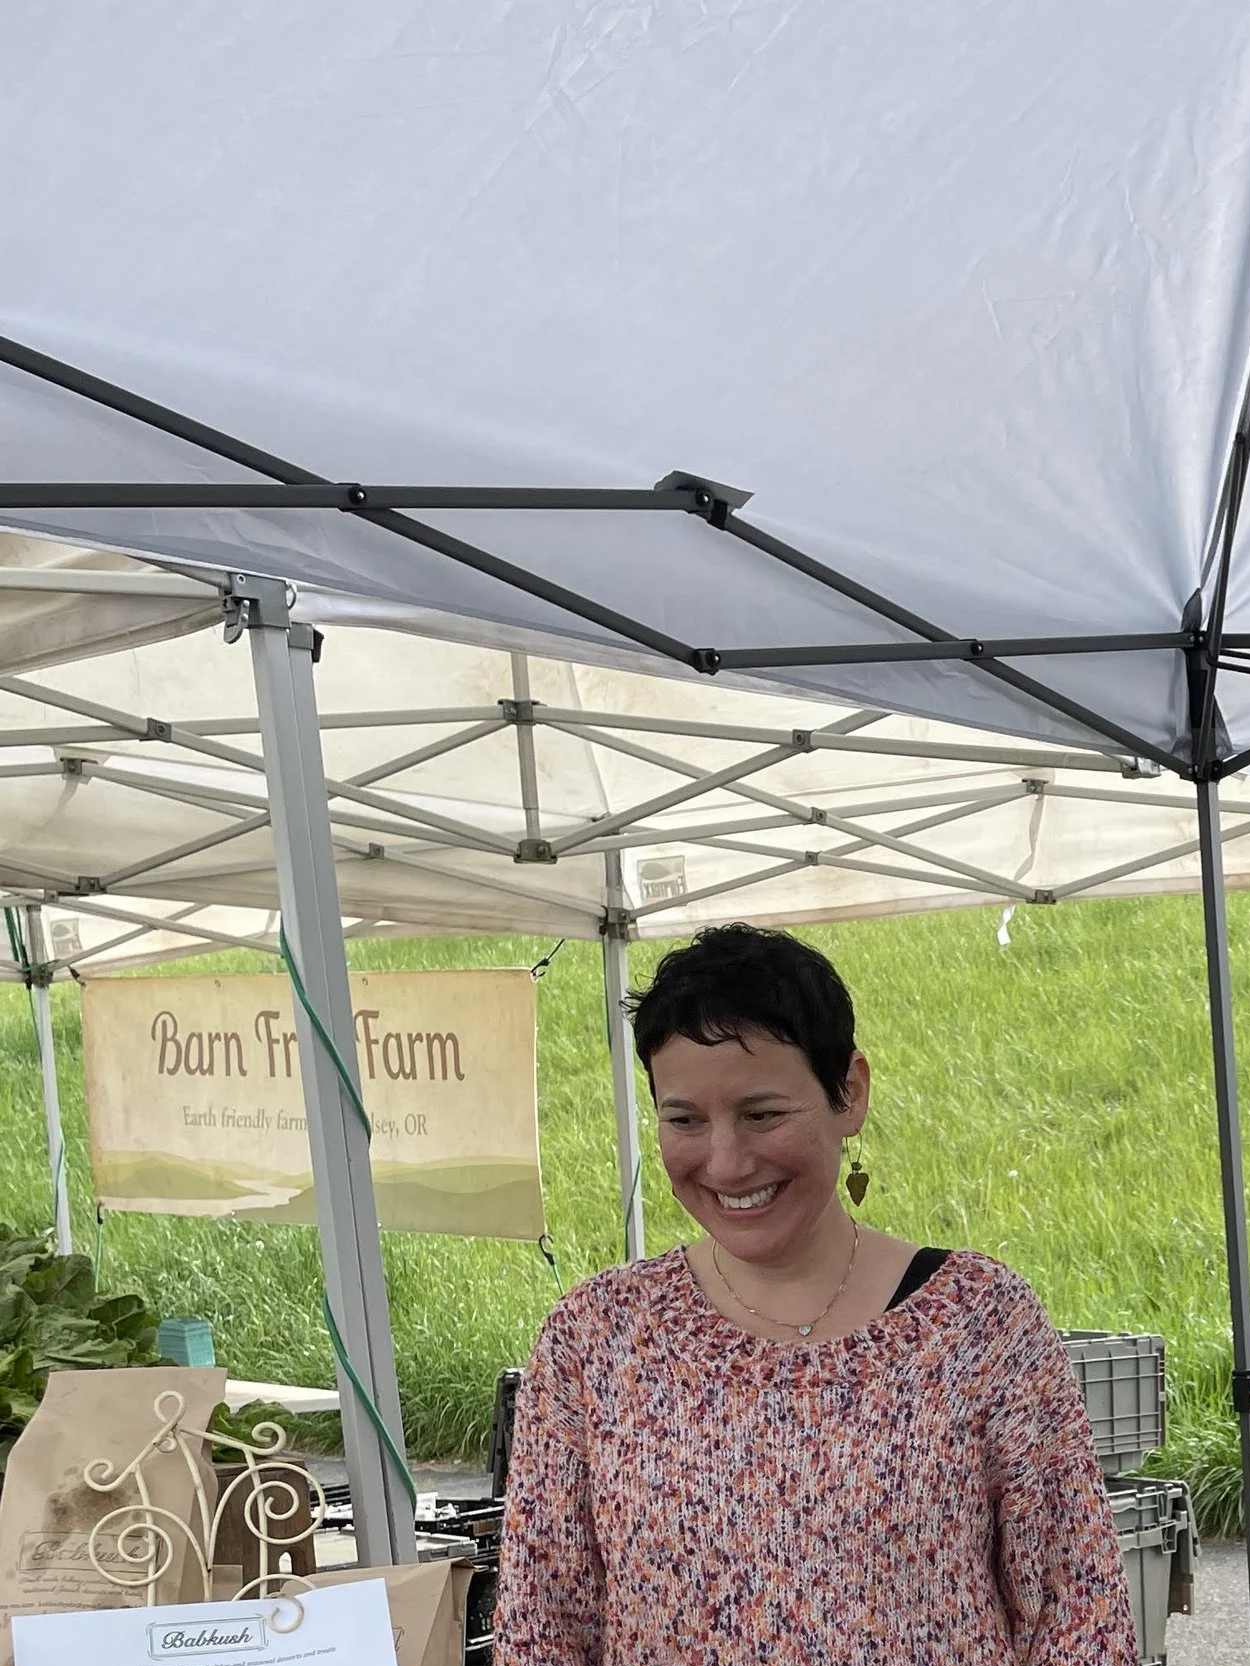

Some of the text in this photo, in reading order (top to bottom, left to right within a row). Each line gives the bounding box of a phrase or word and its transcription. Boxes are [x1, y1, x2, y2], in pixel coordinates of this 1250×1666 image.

[152, 1011, 247, 1076] Barn
[355, 1010, 465, 1081] Farm
[183, 1106, 216, 1128] Earth
[221, 1107, 273, 1132] friendly
[405, 1114, 428, 1136] OR
[161, 1627, 253, 1650] Babkush
